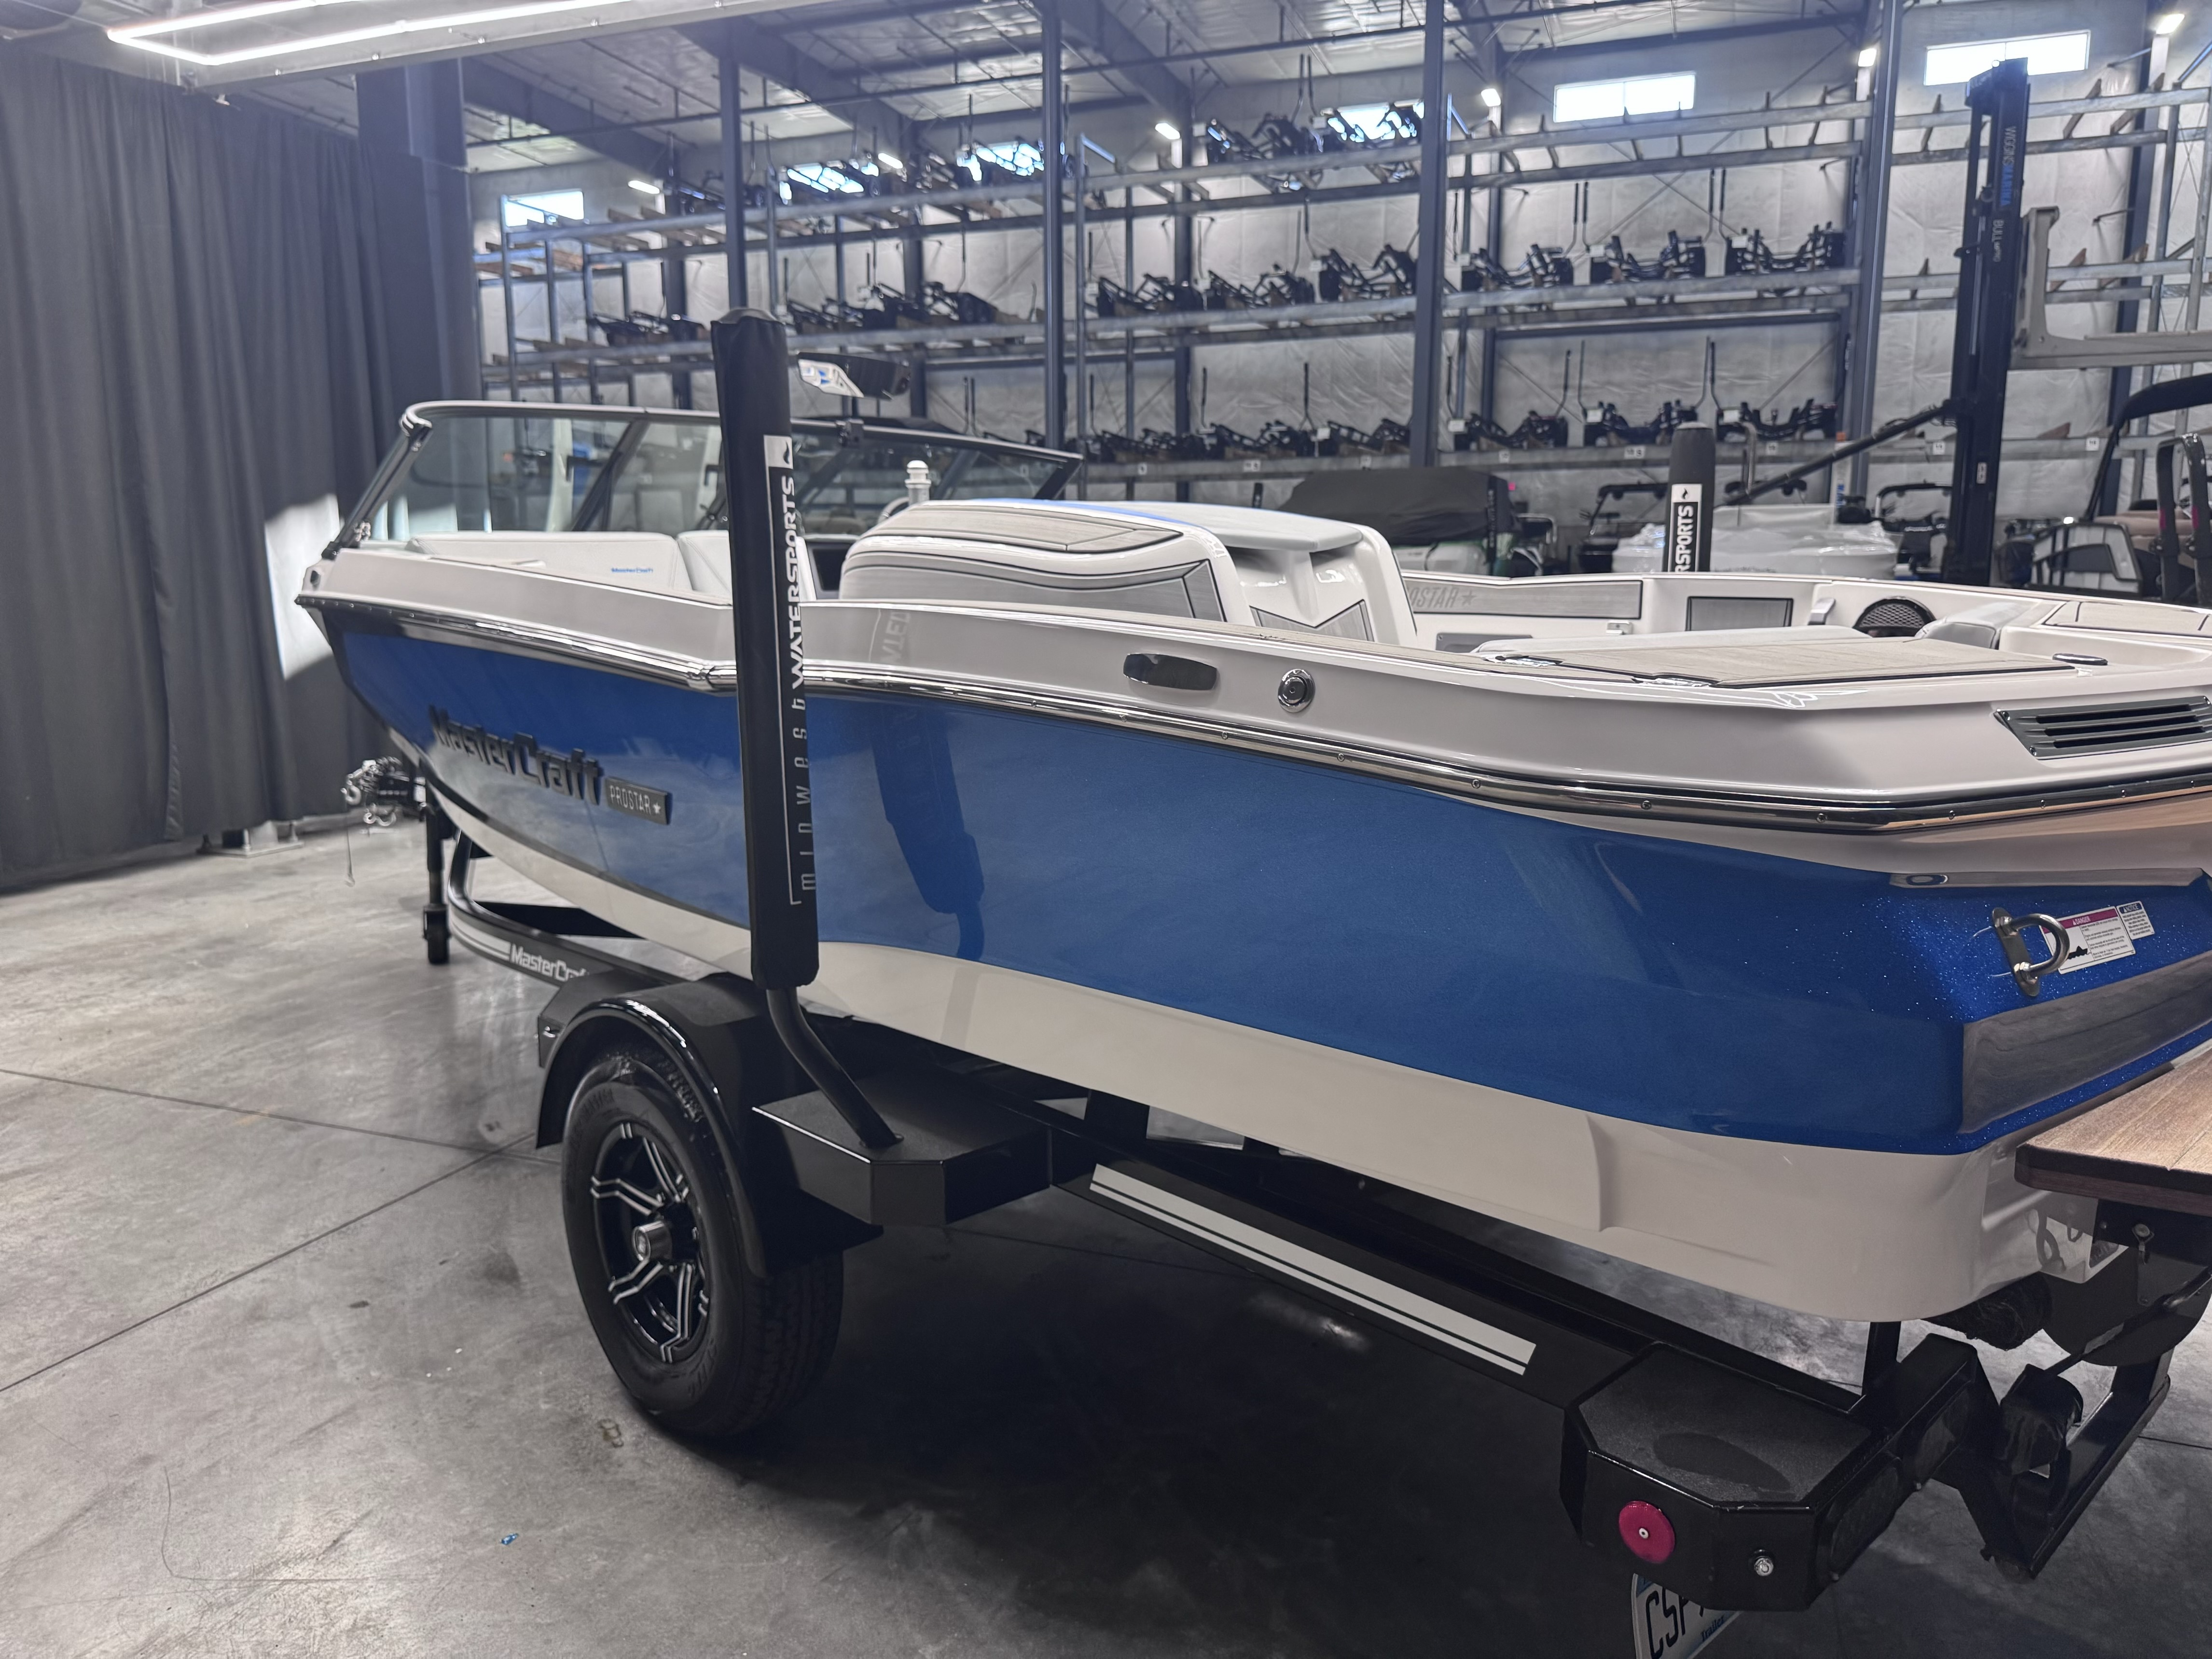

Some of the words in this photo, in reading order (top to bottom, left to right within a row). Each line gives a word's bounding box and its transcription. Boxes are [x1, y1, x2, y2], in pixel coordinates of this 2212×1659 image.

[1991, 219, 2005, 243] BULL
[781, 475, 804, 690] WATERSPORTS
[429, 705, 604, 806] MasterCraft
[609, 785, 651, 815] PROSTAR
[2075, 916, 2091, 925] DANGER
[510, 943, 590, 982] MasterCra
